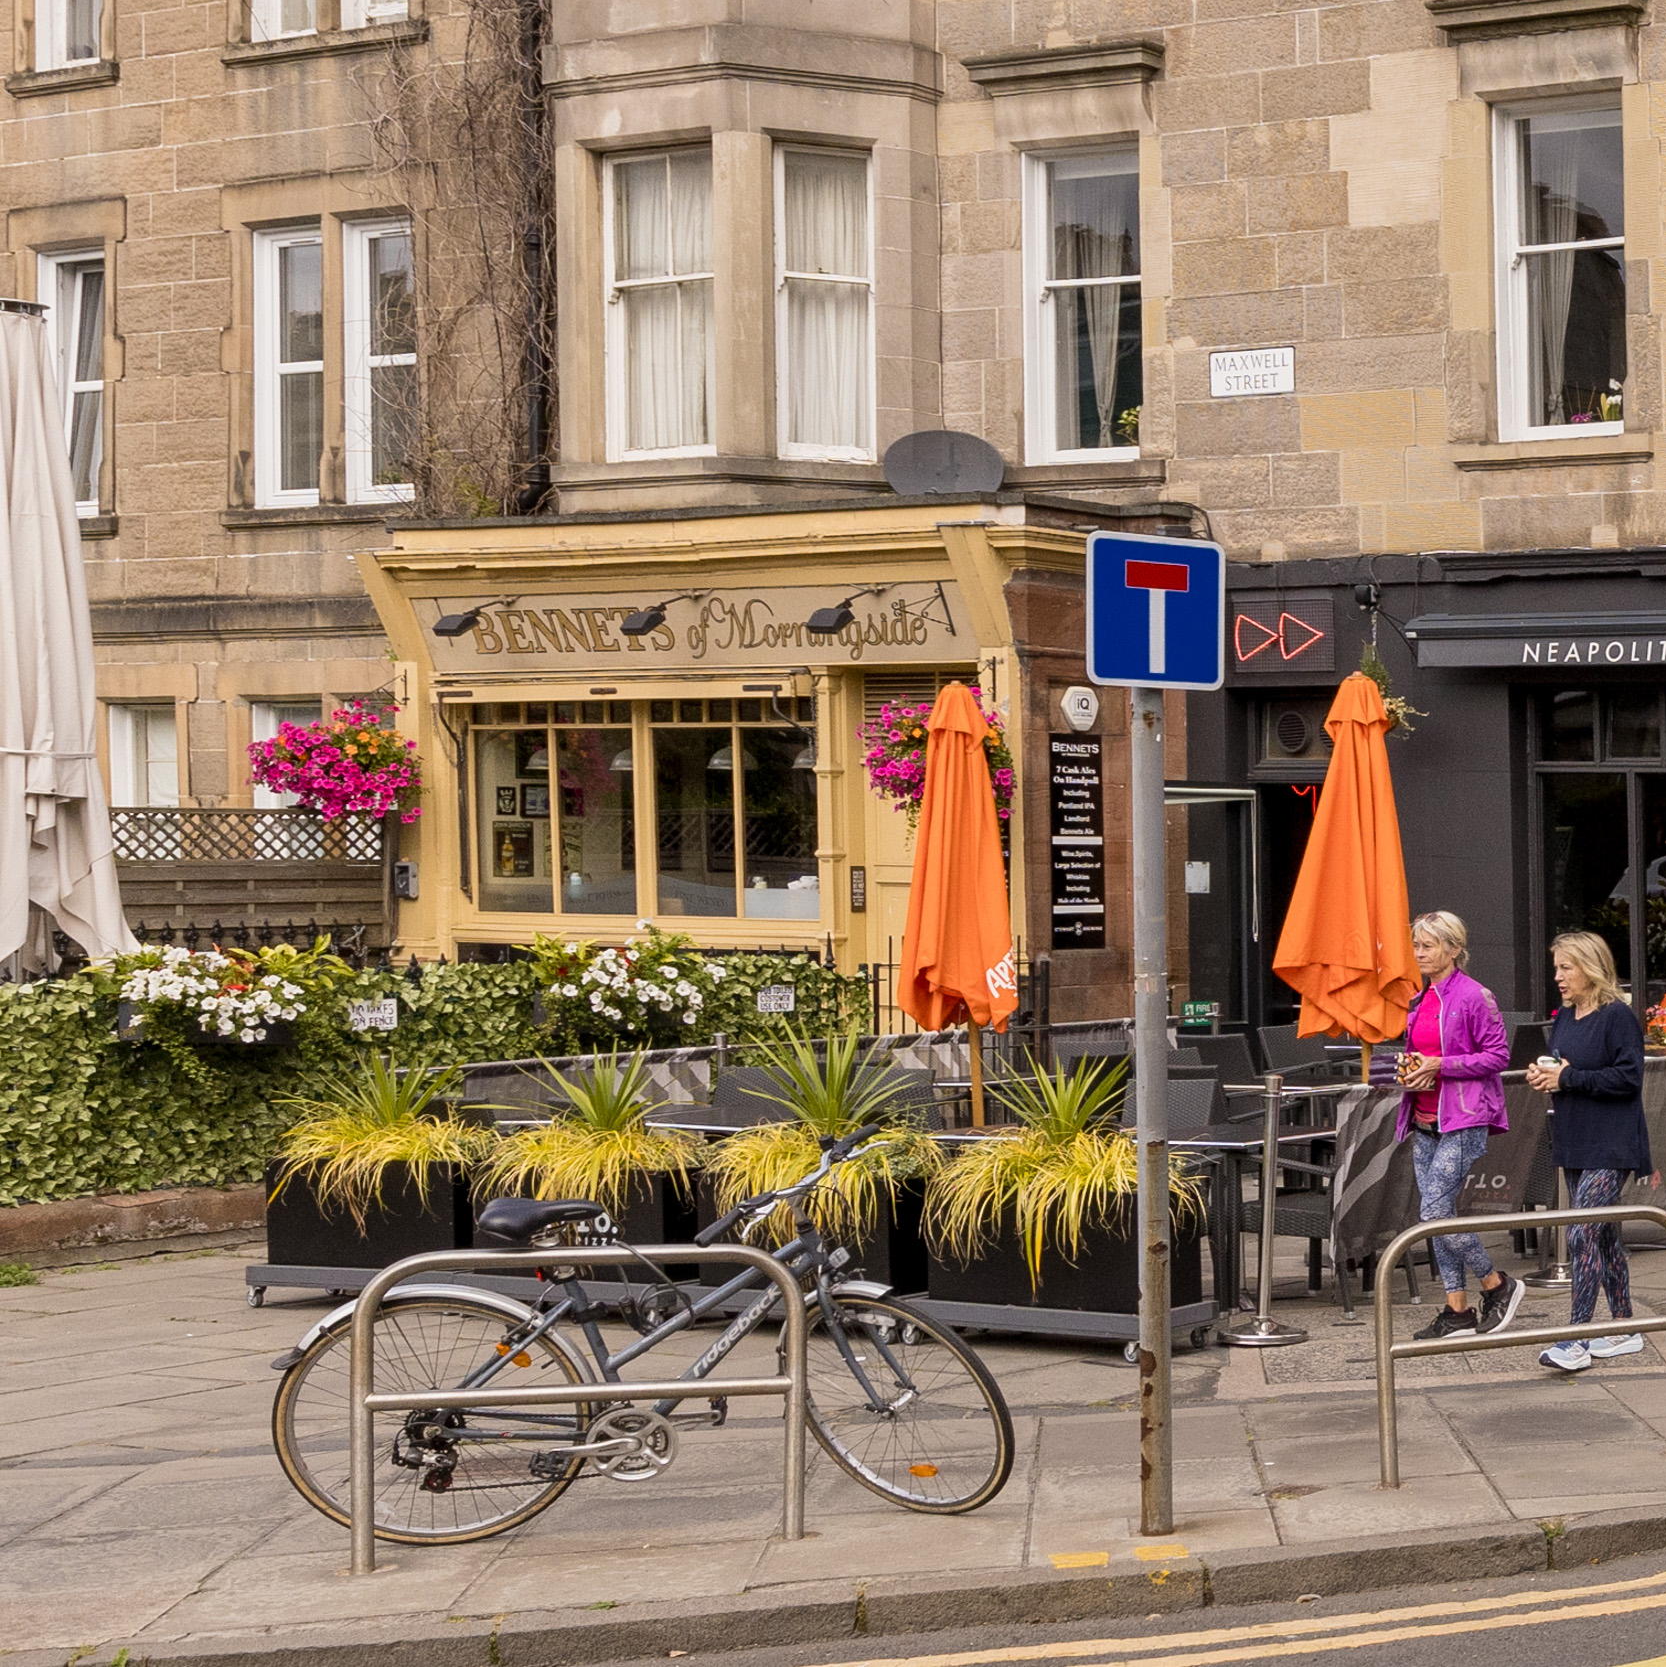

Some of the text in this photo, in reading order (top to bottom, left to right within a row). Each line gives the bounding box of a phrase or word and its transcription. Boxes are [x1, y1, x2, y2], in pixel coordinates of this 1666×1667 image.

[1215, 353, 1288, 372] MAXWELL
[1225, 373, 1278, 391] STREET
[1077, 698, 1090, 710] iQ
[1052, 742, 1100, 754] BENNETS
[369, 1016, 394, 1026] FENCE
[693, 1285, 781, 1377] ridgeback
